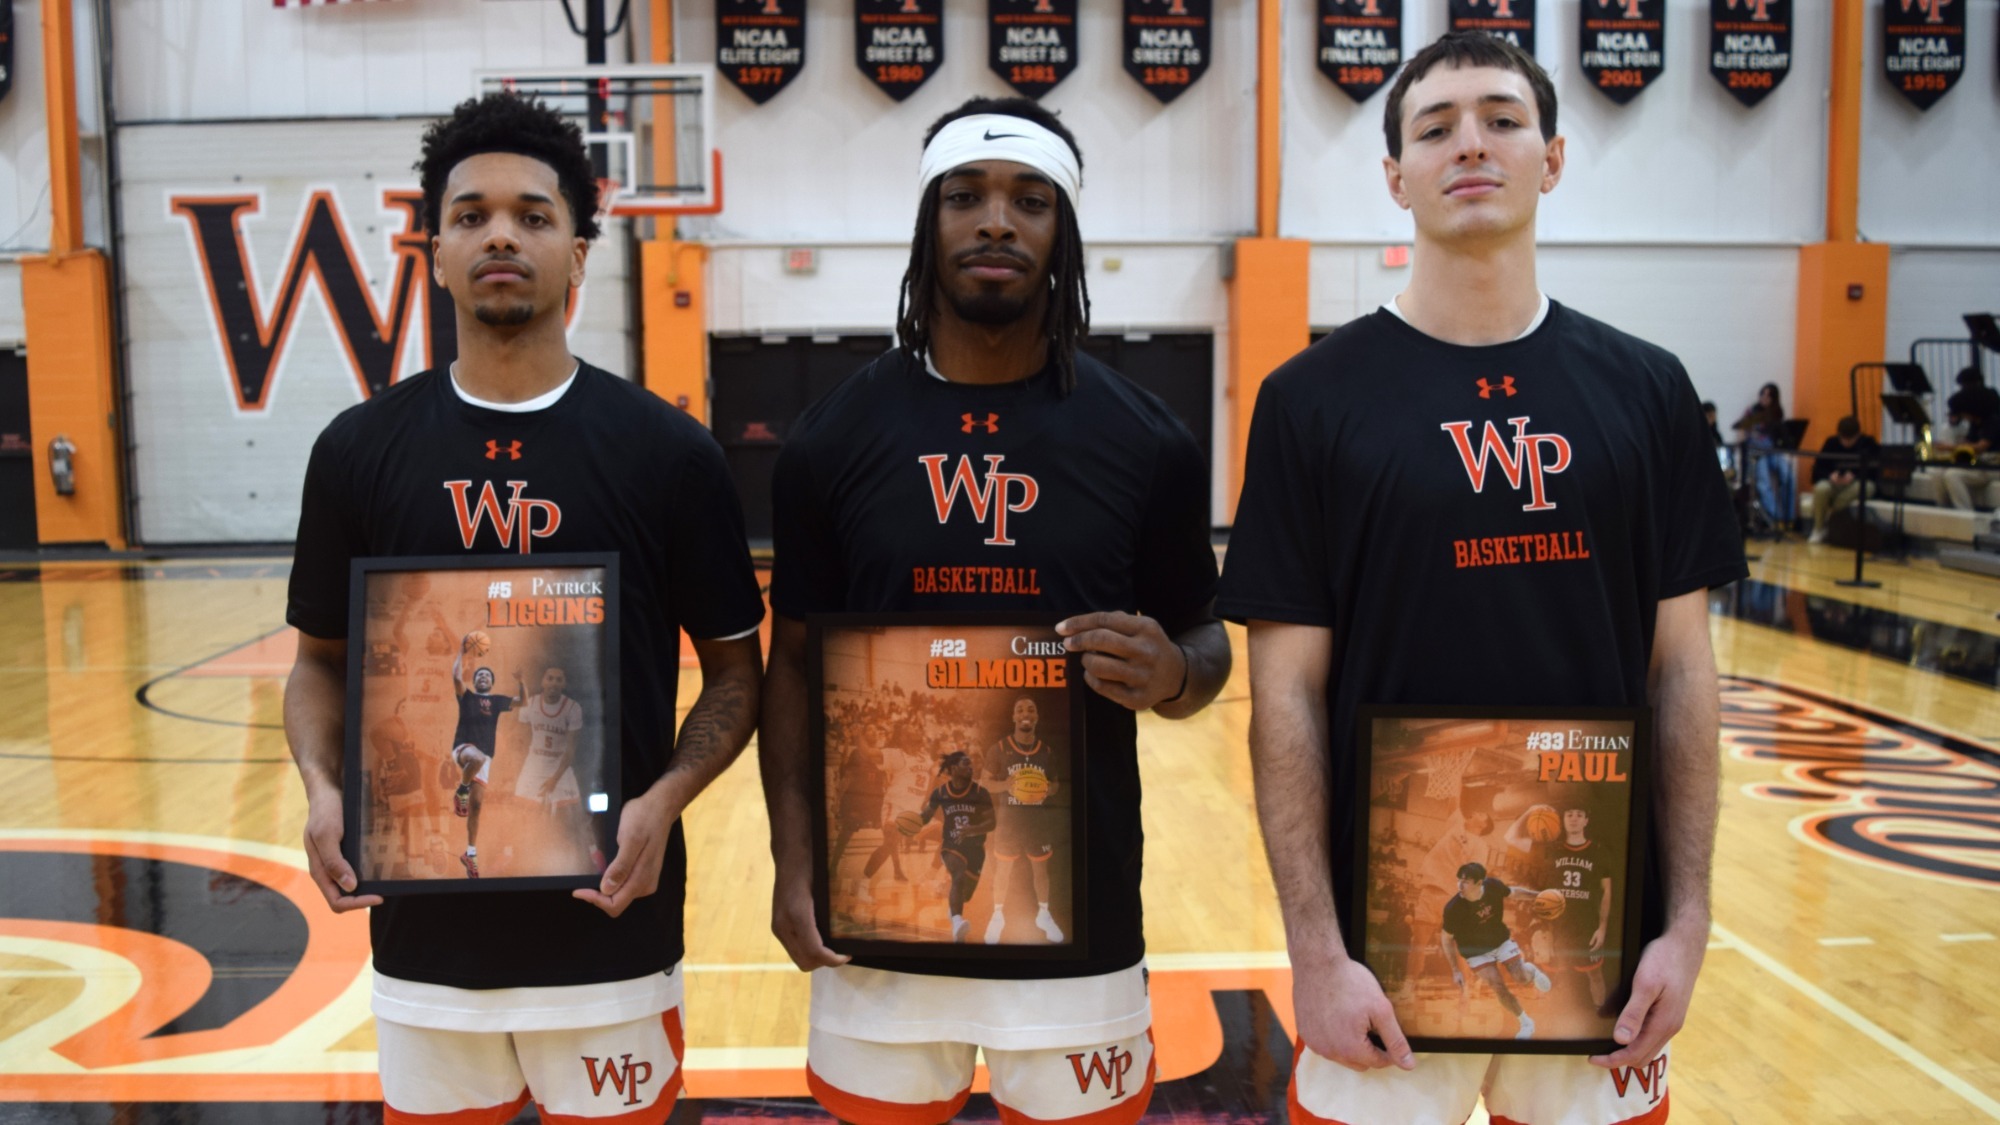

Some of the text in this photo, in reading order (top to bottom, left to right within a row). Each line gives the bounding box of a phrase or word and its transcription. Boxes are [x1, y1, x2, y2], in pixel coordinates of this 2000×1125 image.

[733, 28, 788, 47] NCAA
[873, 27, 926, 46] NCAA
[1006, 27, 1060, 45] NCAA
[1140, 29, 1193, 47] NCAA
[1334, 29, 1386, 47] NCAA
[1597, 33, 1648, 50] NCAA
[1724, 35, 1775, 53] NCAA
[866, 46, 934, 62] SWEET 16
[999, 47, 1067, 62] SWEET 16
[1899, 38, 1948, 55] NCAA
[720, 48, 801, 64] ELITE EIGHT
[1132, 48, 1200, 64] SWEET 16
[1321, 48, 1399, 64] FINAL FOUR
[1583, 52, 1660, 67] FINAL FOUR
[1713, 53, 1789, 69] ELITE EIGHT
[1887, 56, 1961, 71] ELITE EIGHT
[738, 67, 783, 84] 1977
[1011, 66, 1056, 82] 1981
[1144, 67, 1190, 84] 1983
[1338, 67, 1383, 84] 1999
[1599, 70, 1643, 87] 2001
[1728, 72, 1772, 88] 2006
[1440, 416, 1572, 512] WP
[918, 454, 1039, 546] WP
[443, 480, 562, 555] WP
[1453, 530, 1590, 568] BASKETBALL
[488, 581, 512, 599] #5
[913, 567, 1041, 595] BASKETBALL
[487, 597, 605, 628] LIGGINS
[930, 639, 967, 658] #22
[927, 658, 1067, 689] GILMORE
[1526, 731, 1565, 751] #33
[1538, 752, 1627, 783] PAUL
[1555, 856, 1593, 871] WILLIAM
[1563, 870, 1581, 888] 33
[581, 1053, 652, 1106] WP
[1065, 1045, 1133, 1100] WP
